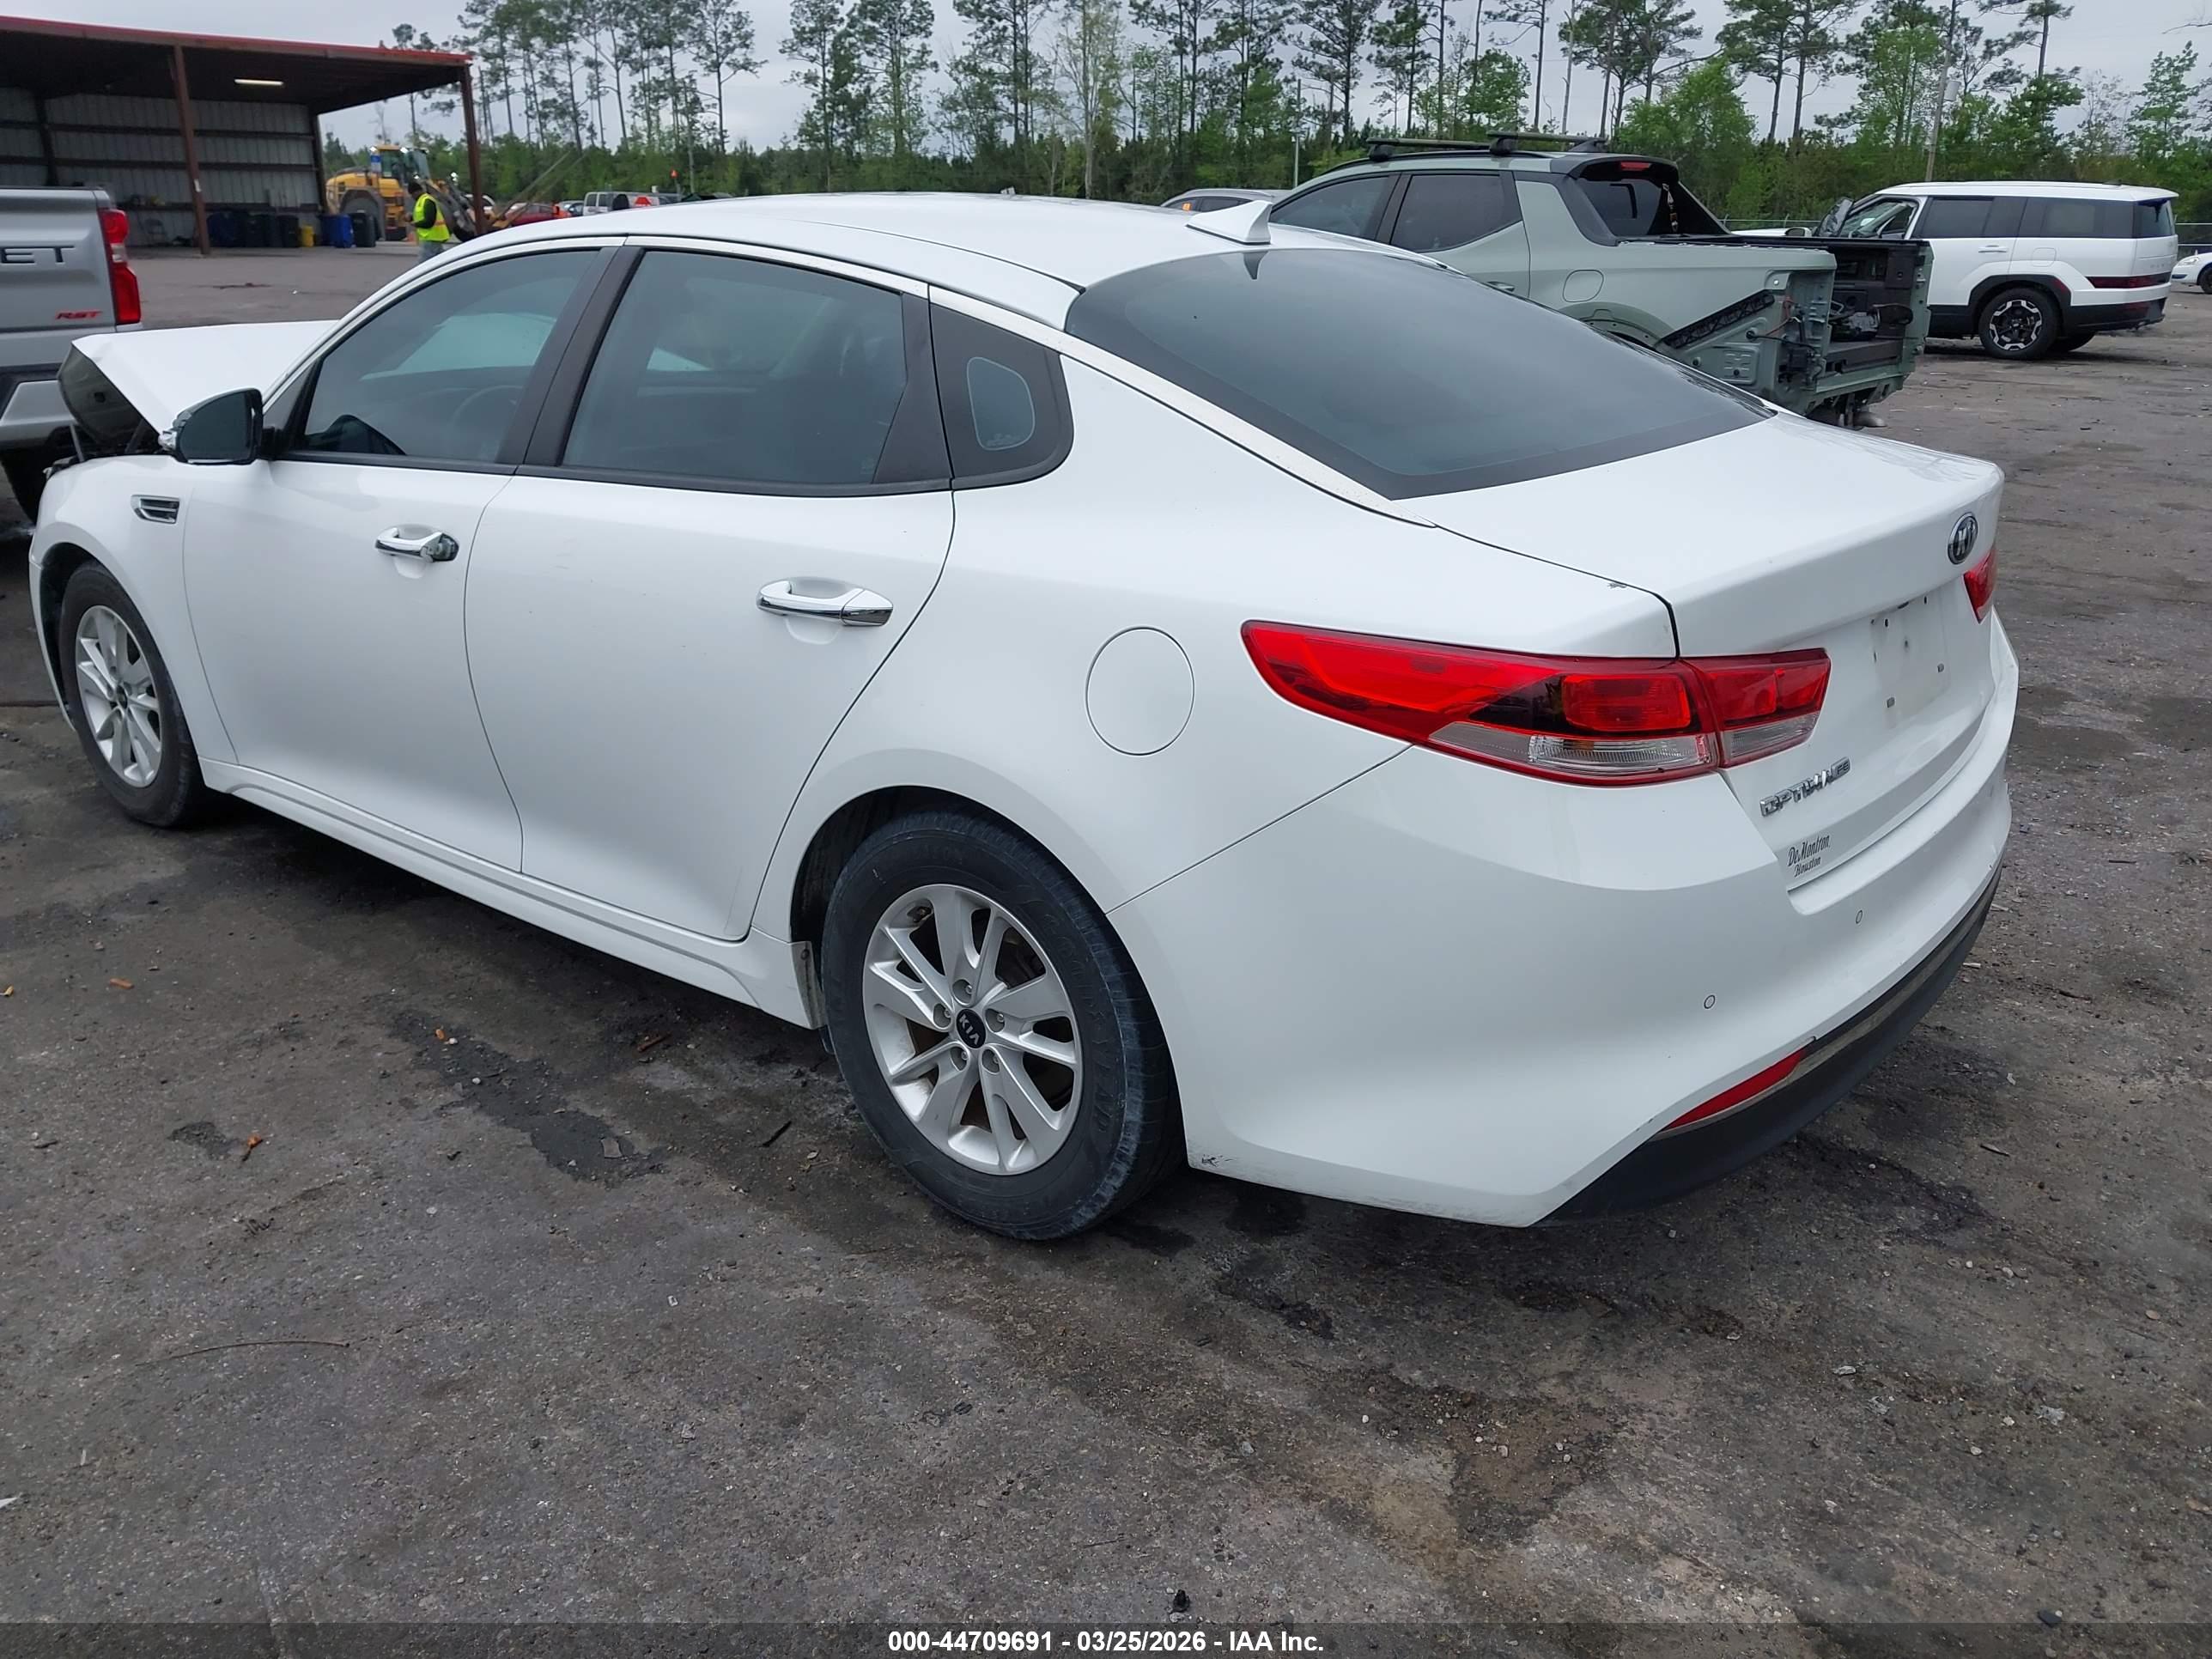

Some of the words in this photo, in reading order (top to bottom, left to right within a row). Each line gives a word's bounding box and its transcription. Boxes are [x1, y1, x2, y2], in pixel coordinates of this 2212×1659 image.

[55, 310, 103, 320] RST
[1794, 856, 1821, 878] Houston
[959, 1013, 981, 1046] KIA
